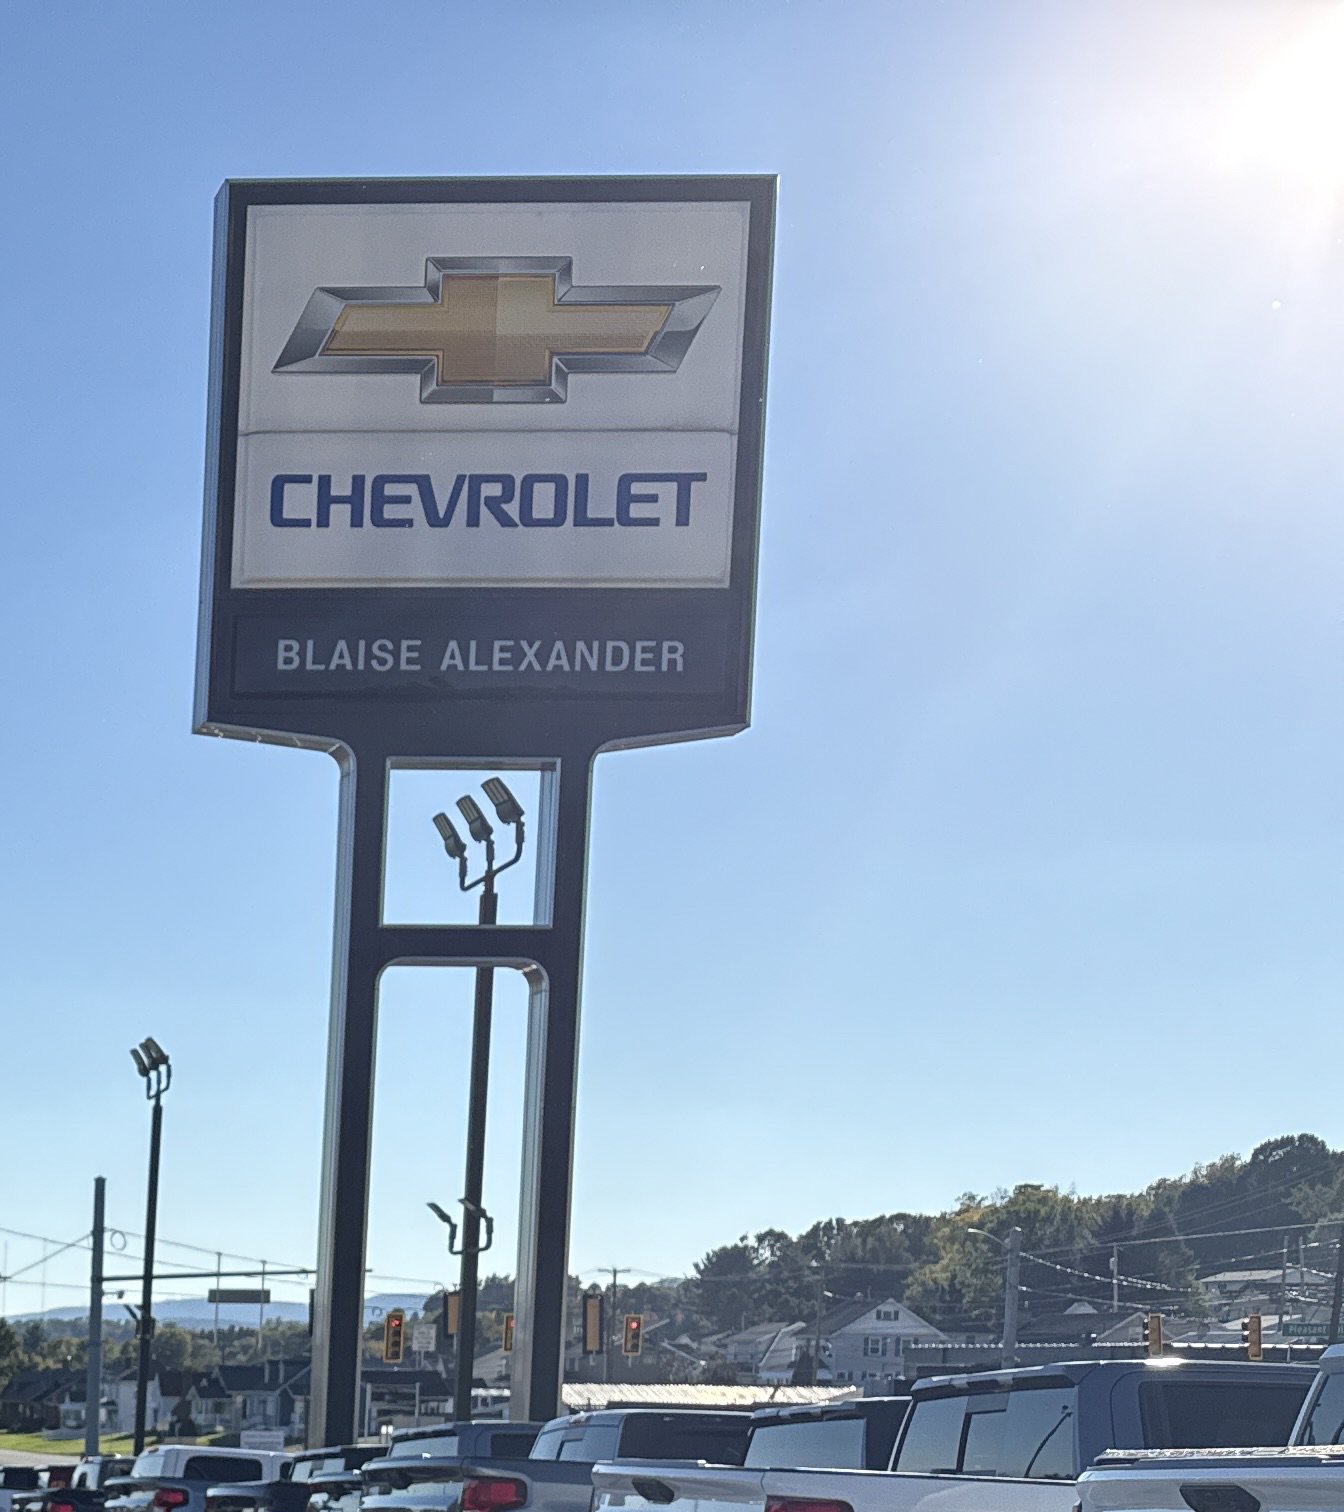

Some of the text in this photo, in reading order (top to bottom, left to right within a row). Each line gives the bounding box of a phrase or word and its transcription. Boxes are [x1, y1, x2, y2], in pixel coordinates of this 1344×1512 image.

[270, 472, 708, 528] CHEVROLET
[276, 639, 685, 673] BLAISE ALEXANDER
